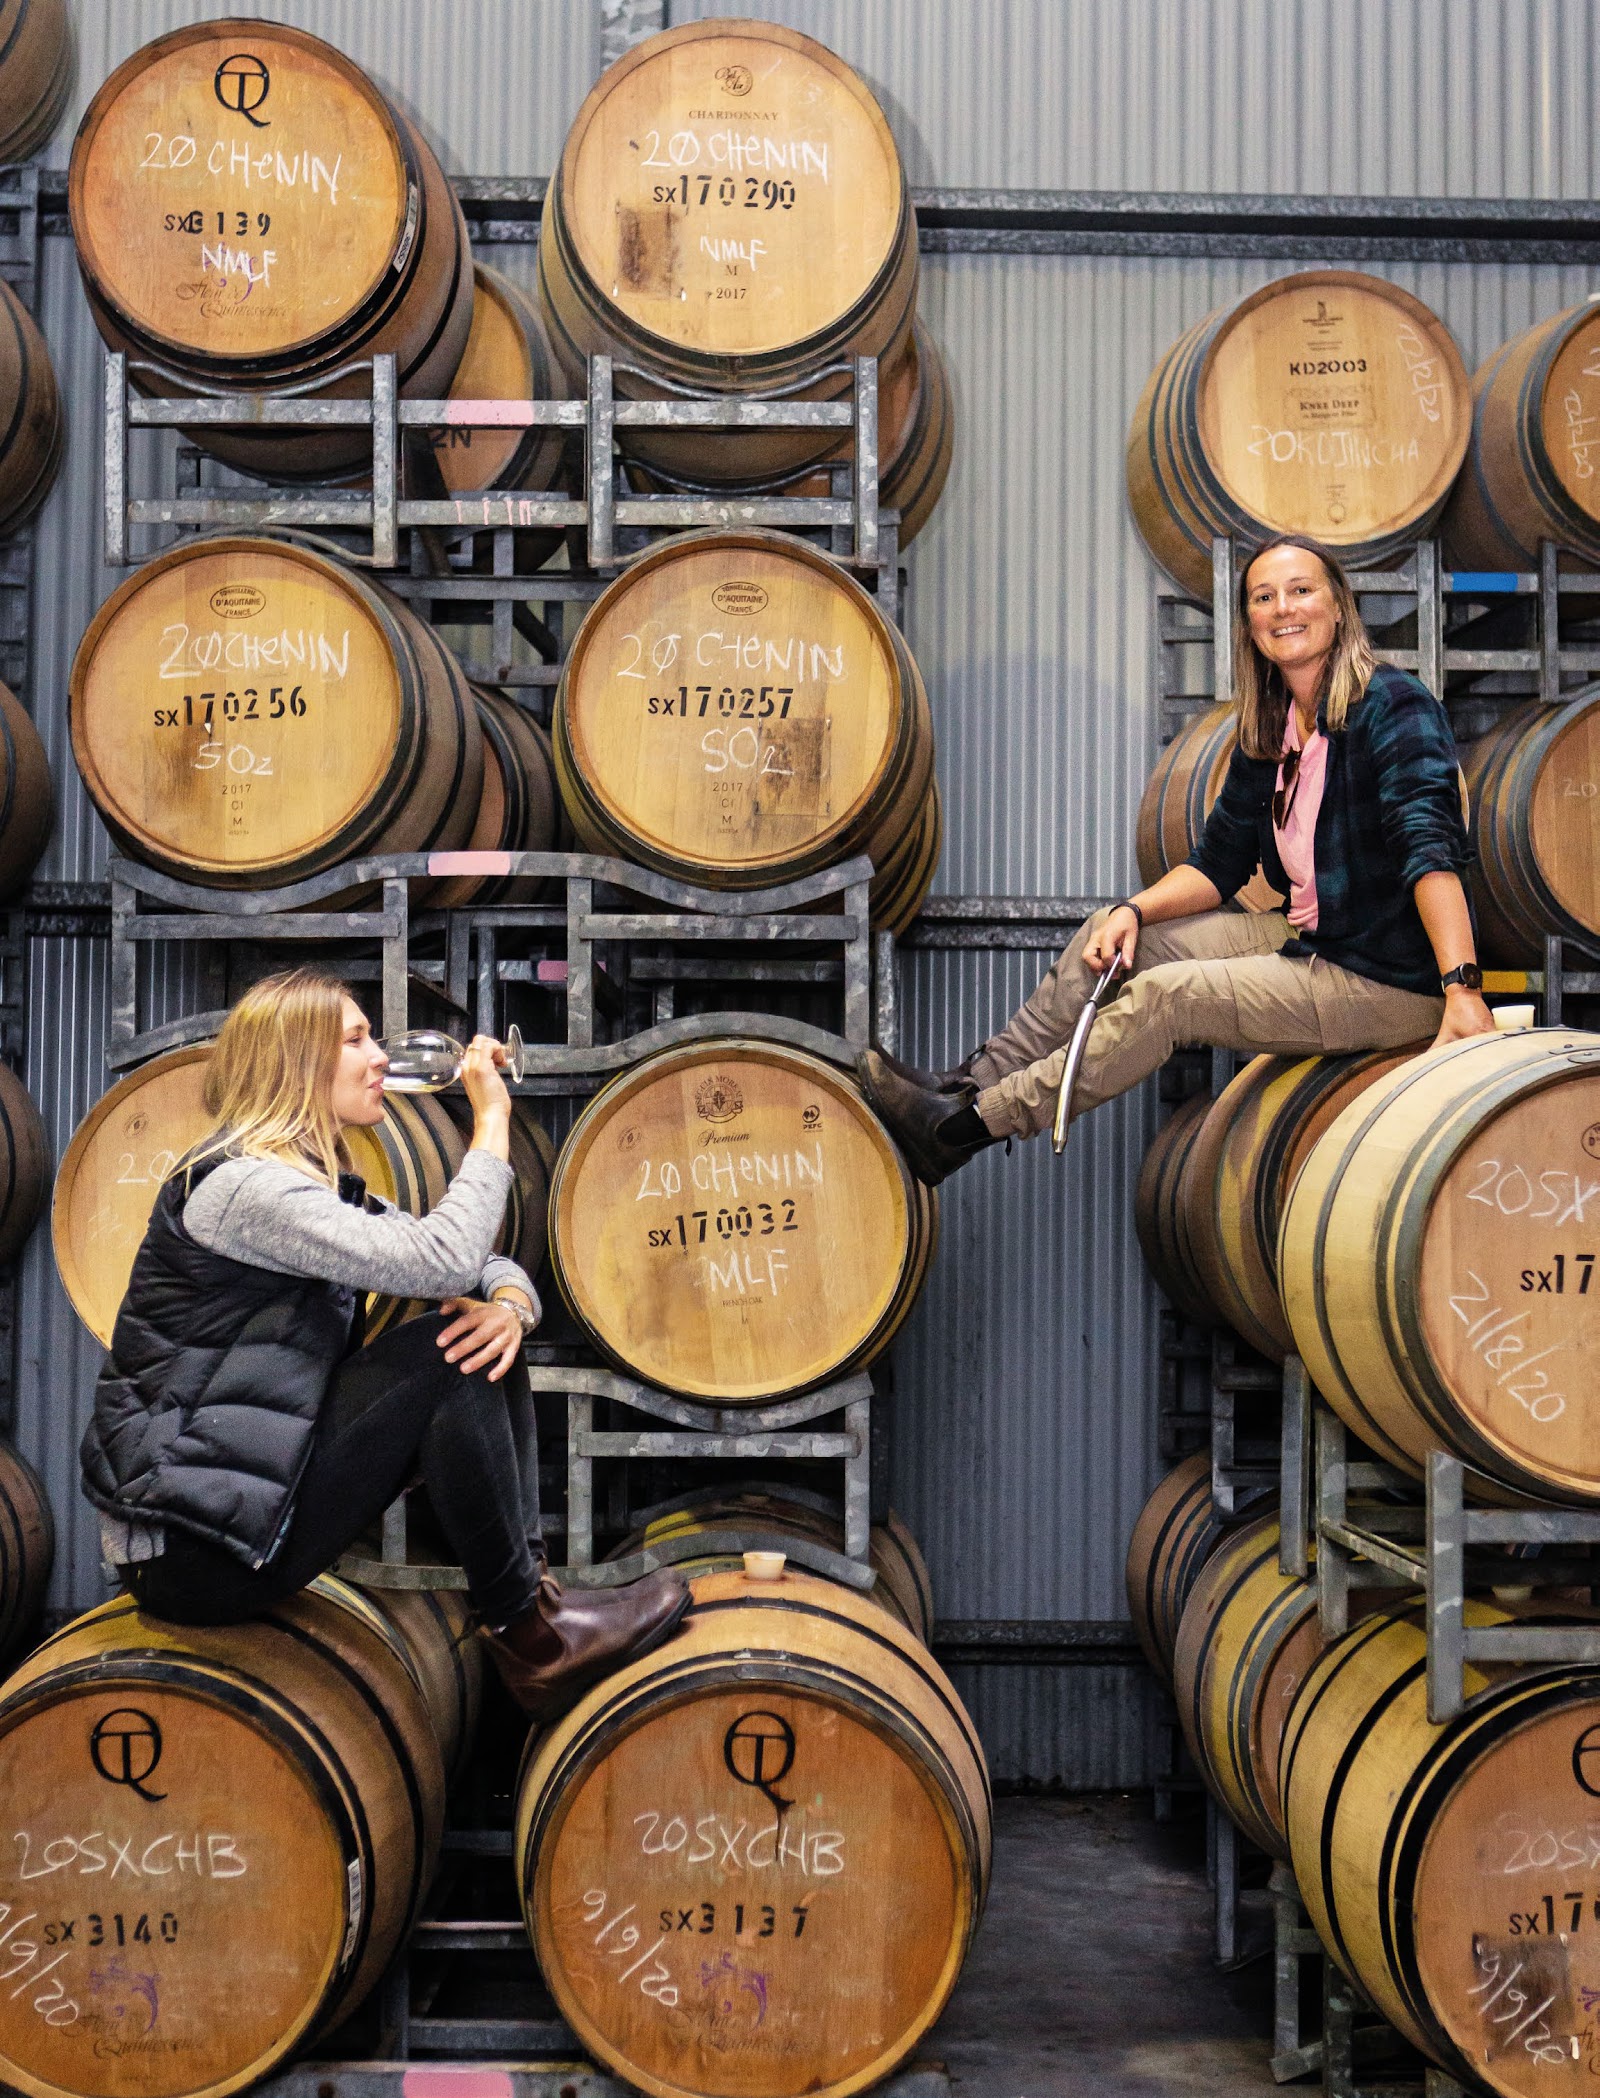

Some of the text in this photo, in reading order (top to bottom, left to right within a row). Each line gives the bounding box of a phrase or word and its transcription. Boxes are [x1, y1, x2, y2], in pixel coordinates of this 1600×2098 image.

[688, 110, 779, 121] CHARDONNAY
[699, 235, 767, 271] NMLF
[715, 288, 747, 300] 2017
[1289, 359, 1367, 377] KD2003
[222, 783, 252, 795] 2017
[712, 781, 743, 792] 2017
[232, 817, 242, 826] M
[722, 815, 732, 824] M
[697, 1128, 751, 1148] Premium
[709, 1248, 789, 1296] MLF
